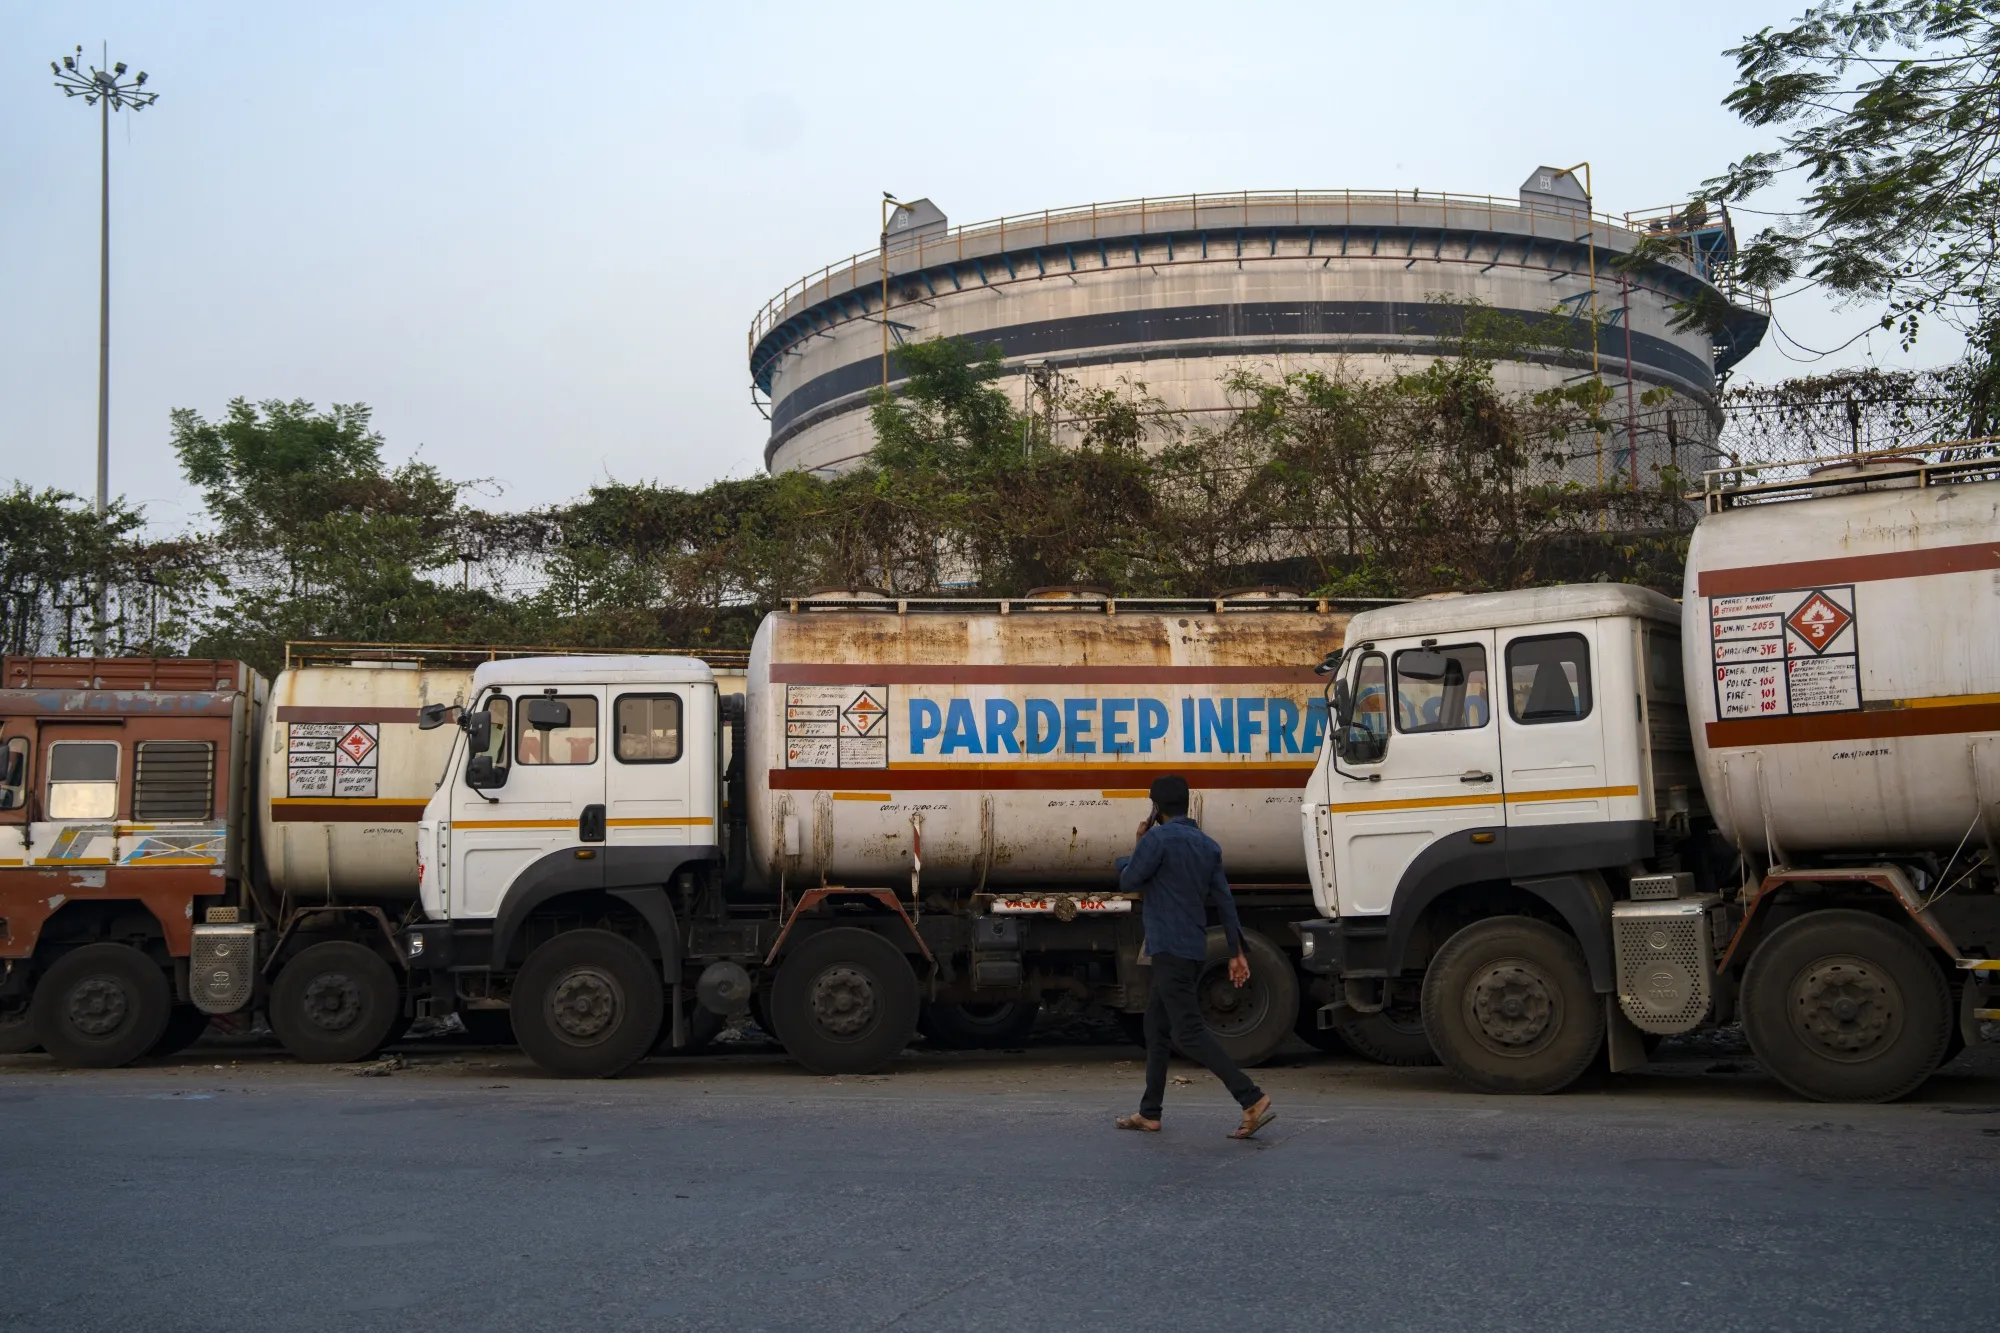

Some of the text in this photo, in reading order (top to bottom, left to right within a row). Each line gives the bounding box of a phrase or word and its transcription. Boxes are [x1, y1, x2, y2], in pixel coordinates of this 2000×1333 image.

[1752, 620, 1775, 632] 2055
[1811, 623, 1825, 638] 3
[1726, 687, 1775, 702] FIRE 101
[1760, 700, 1776, 712] 108
[857, 714, 869, 729] 3
[908, 698, 1170, 754] PARDEEP
[354, 744, 361, 755] 3
[301, 783, 315, 791] FIRE
[338, 777, 355, 785] WASH
[343, 785, 366, 793] WATER
[1004, 900, 1107, 910] VALVE BOX
